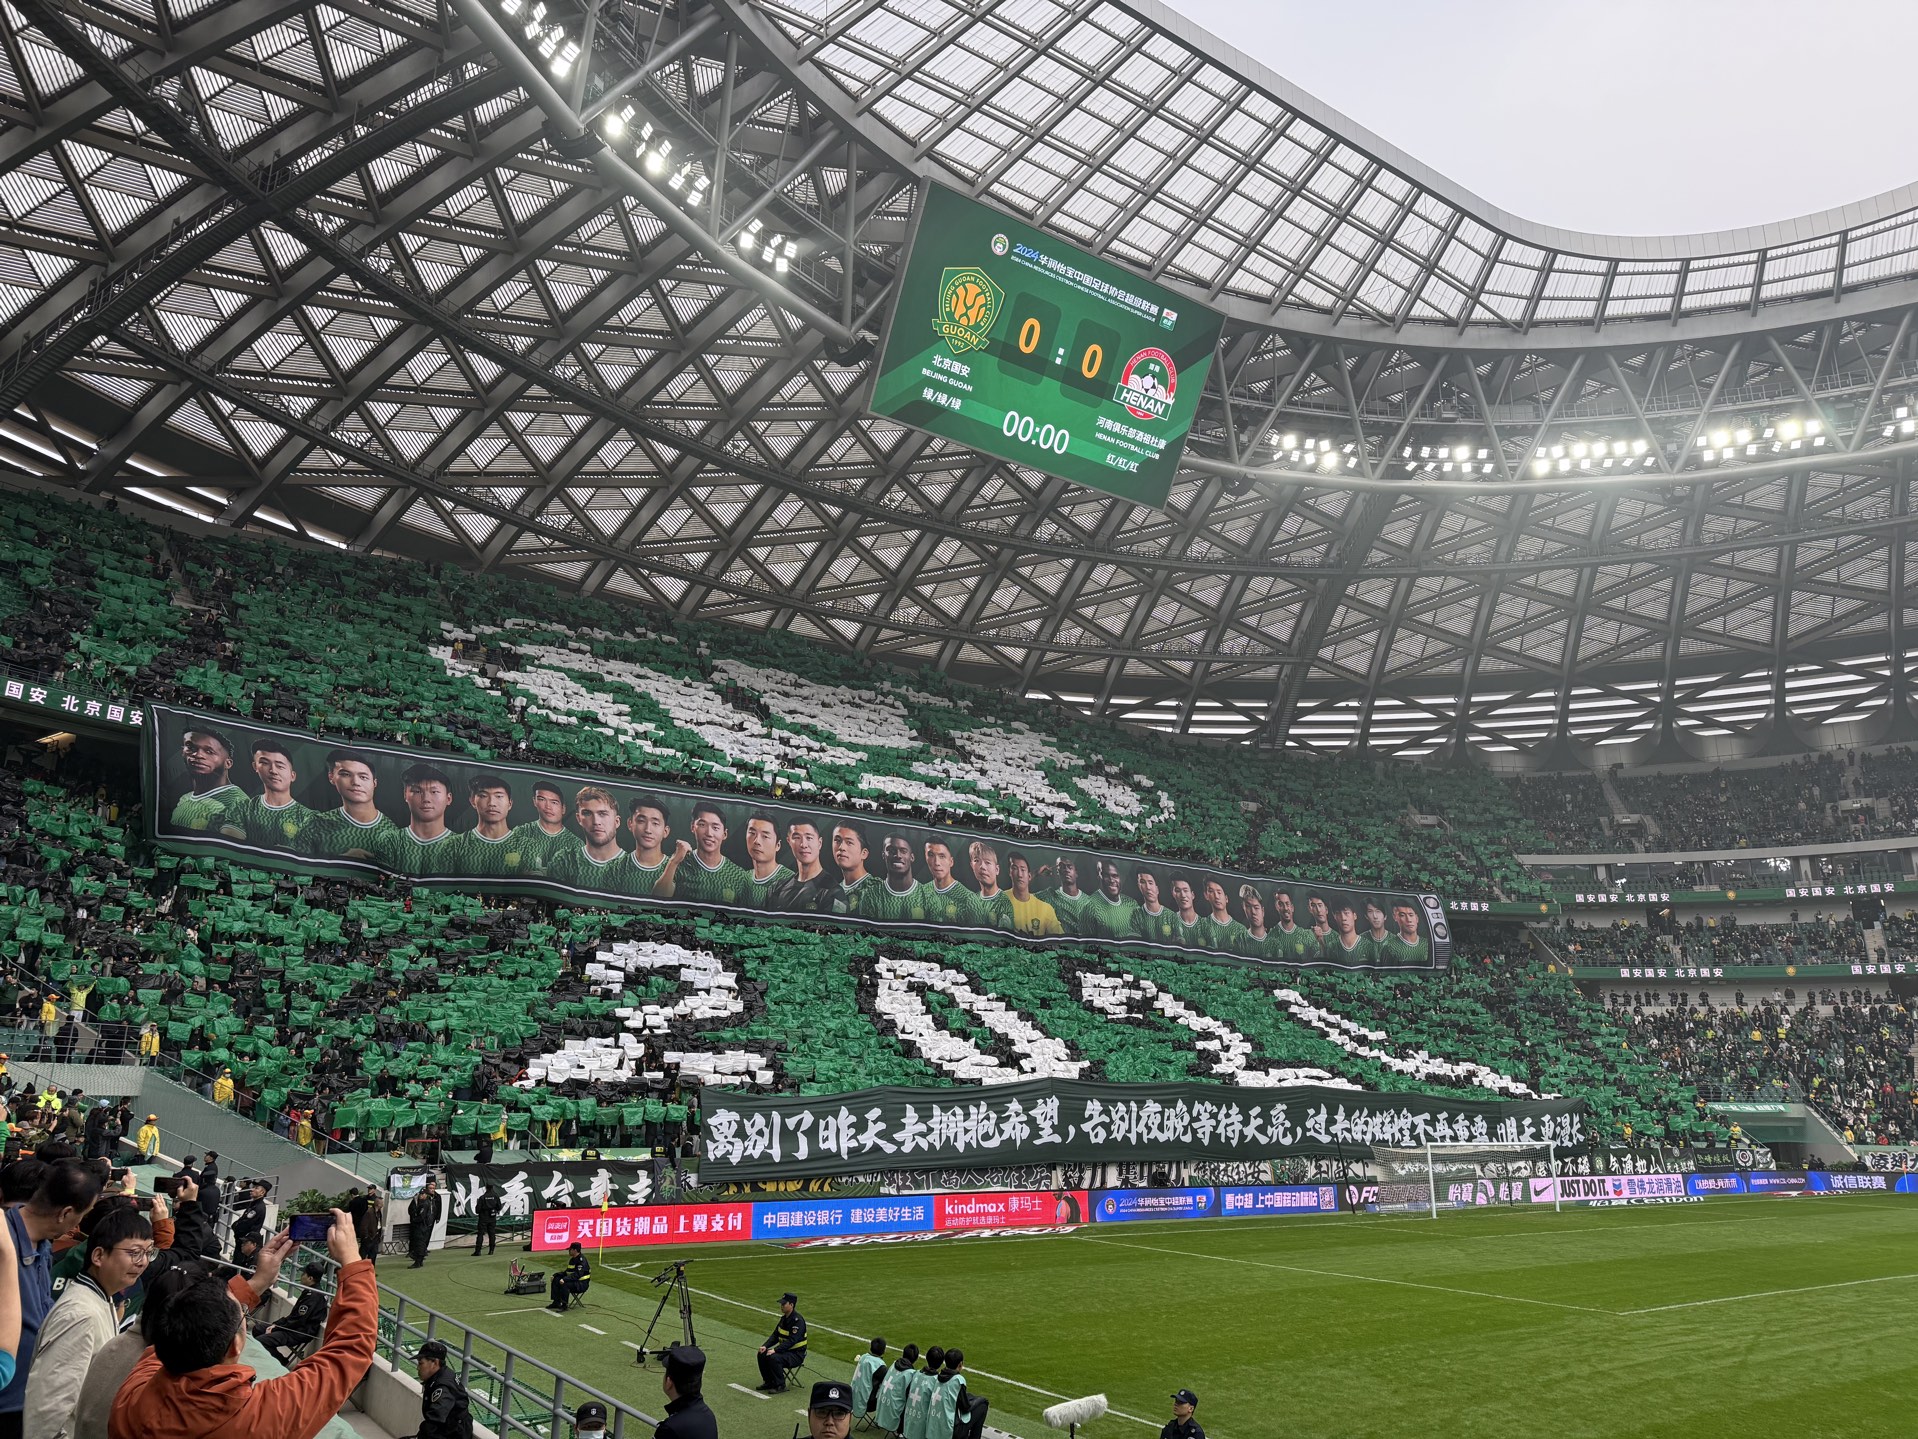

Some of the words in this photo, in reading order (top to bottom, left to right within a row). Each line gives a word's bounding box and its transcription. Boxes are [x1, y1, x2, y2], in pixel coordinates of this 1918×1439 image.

[942, 324, 979, 346] GUOAN
[952, 338, 965, 349] 1992
[1018, 317, 1041, 354] 0
[1081, 344, 1104, 379] 0
[932, 354, 971, 378] 北京国安
[922, 368, 948, 383] BEIJING
[948, 377, 973, 392] GUOAN
[1120, 388, 1166, 415] HENAN
[1002, 410, 1070, 455] 00:00
[1096, 416, 1167, 450] 河南俱乐部酒祖杜康
[1095, 432, 1115, 444] HENAN
[1116, 438, 1144, 455] FOOTBALL
[1144, 450, 1160, 460] CLUB
[1106, 453, 1140, 473] 红/红/红
[4, 680, 48, 705] 国安
[61, 694, 144, 726] 北京国安
[1576, 893, 1619, 903] 国安国安
[1626, 892, 1670, 902] 北京国安
[1786, 886, 1836, 898] 国安国安
[1844, 882, 1895, 895] 北京国安
[1450, 901, 1490, 912] 北京国安
[1620, 968, 1668, 978] 国安国安
[1674, 968, 1724, 978] 北京国安
[1851, 964, 1906, 975] 国安国安
[1560, 1179, 1582, 1198] JUST
[1582, 1178, 1598, 1197] DO
[1599, 1178, 1610, 1197] IT.
[1626, 1177, 1683, 1196] 雪佛龙润滑油
[1830, 1174, 1887, 1190] 诚信联赛
[1225, 1192, 1253, 1210] 看中超
[1255, 1191, 1318, 1208] 上中国移动咪咕
[1360, 1186, 1379, 1203] FC
[945, 1197, 1006, 1215] kindmax
[1008, 1196, 1043, 1212] 康玛士
[576, 1216, 668, 1239] 买国货潮品
[674, 1212, 744, 1234] 上翼支付
[763, 1209, 843, 1228] 中国建设银行
[850, 1206, 925, 1224] 建设美好生活
